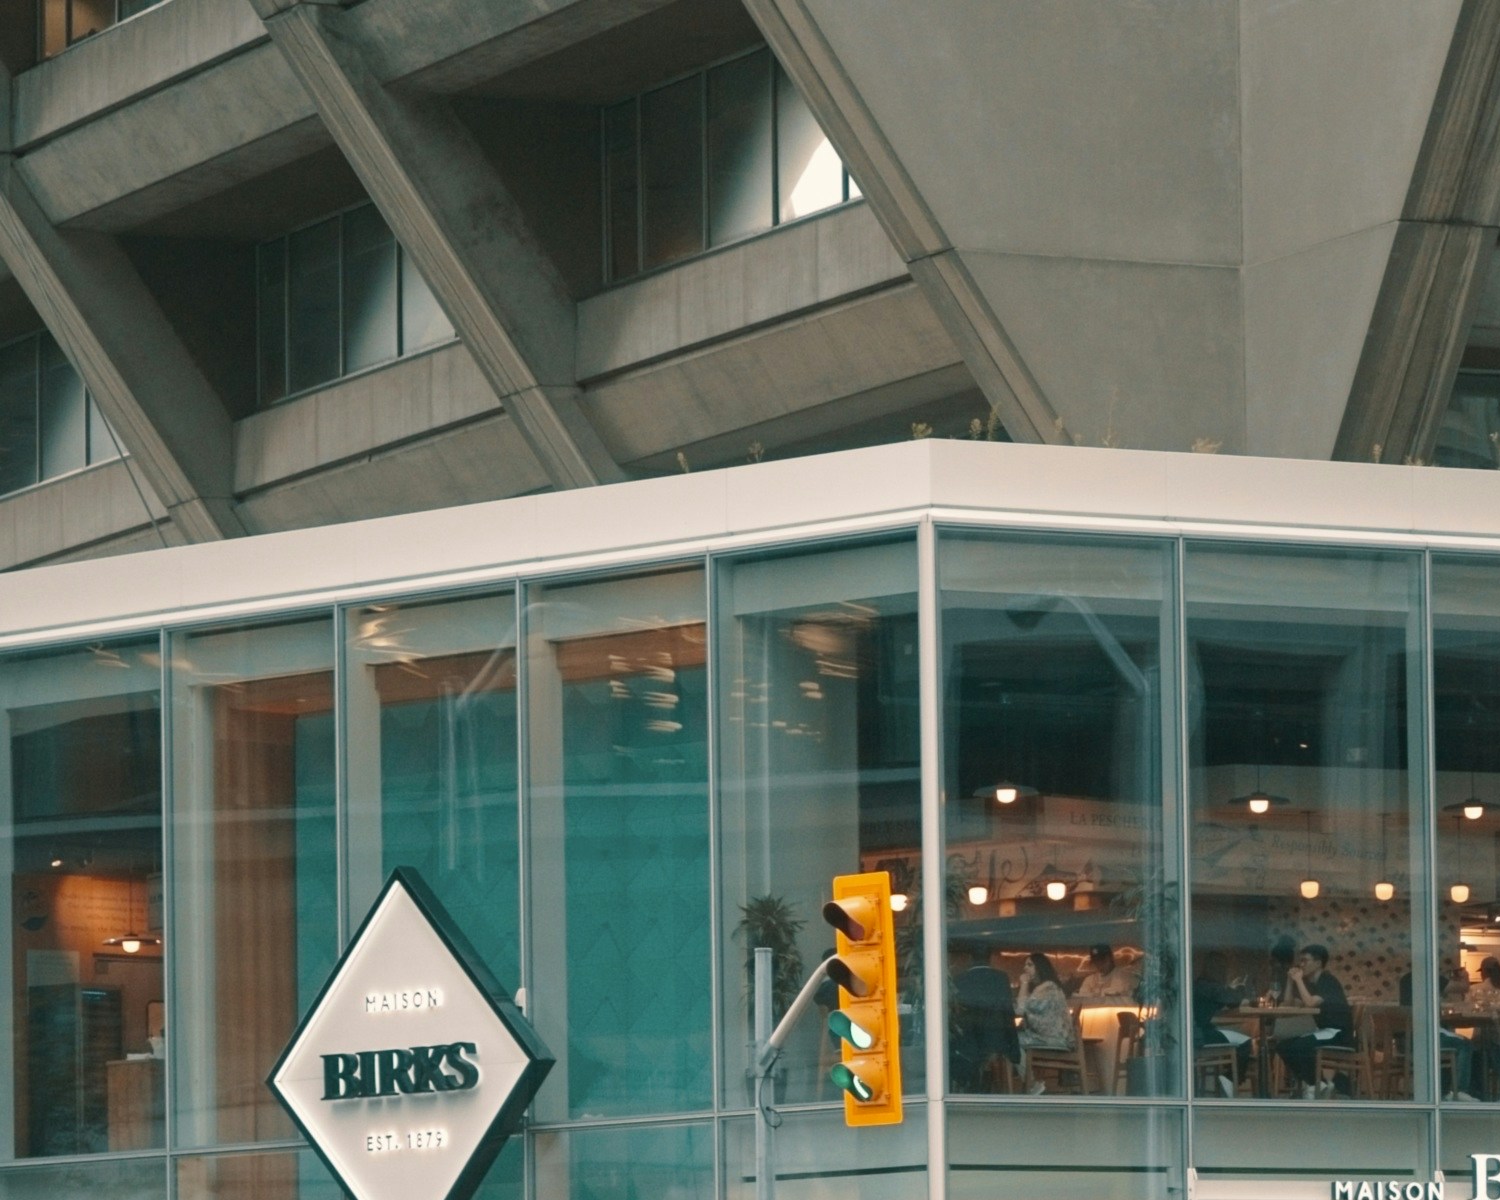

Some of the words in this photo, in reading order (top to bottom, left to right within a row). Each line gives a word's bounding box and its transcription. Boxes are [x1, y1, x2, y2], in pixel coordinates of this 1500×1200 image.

[365, 989, 439, 1012] MAISON
[320, 1042, 480, 1101] BIRKS
[367, 1135, 399, 1151] EST.
[408, 1131, 443, 1149] 1879
